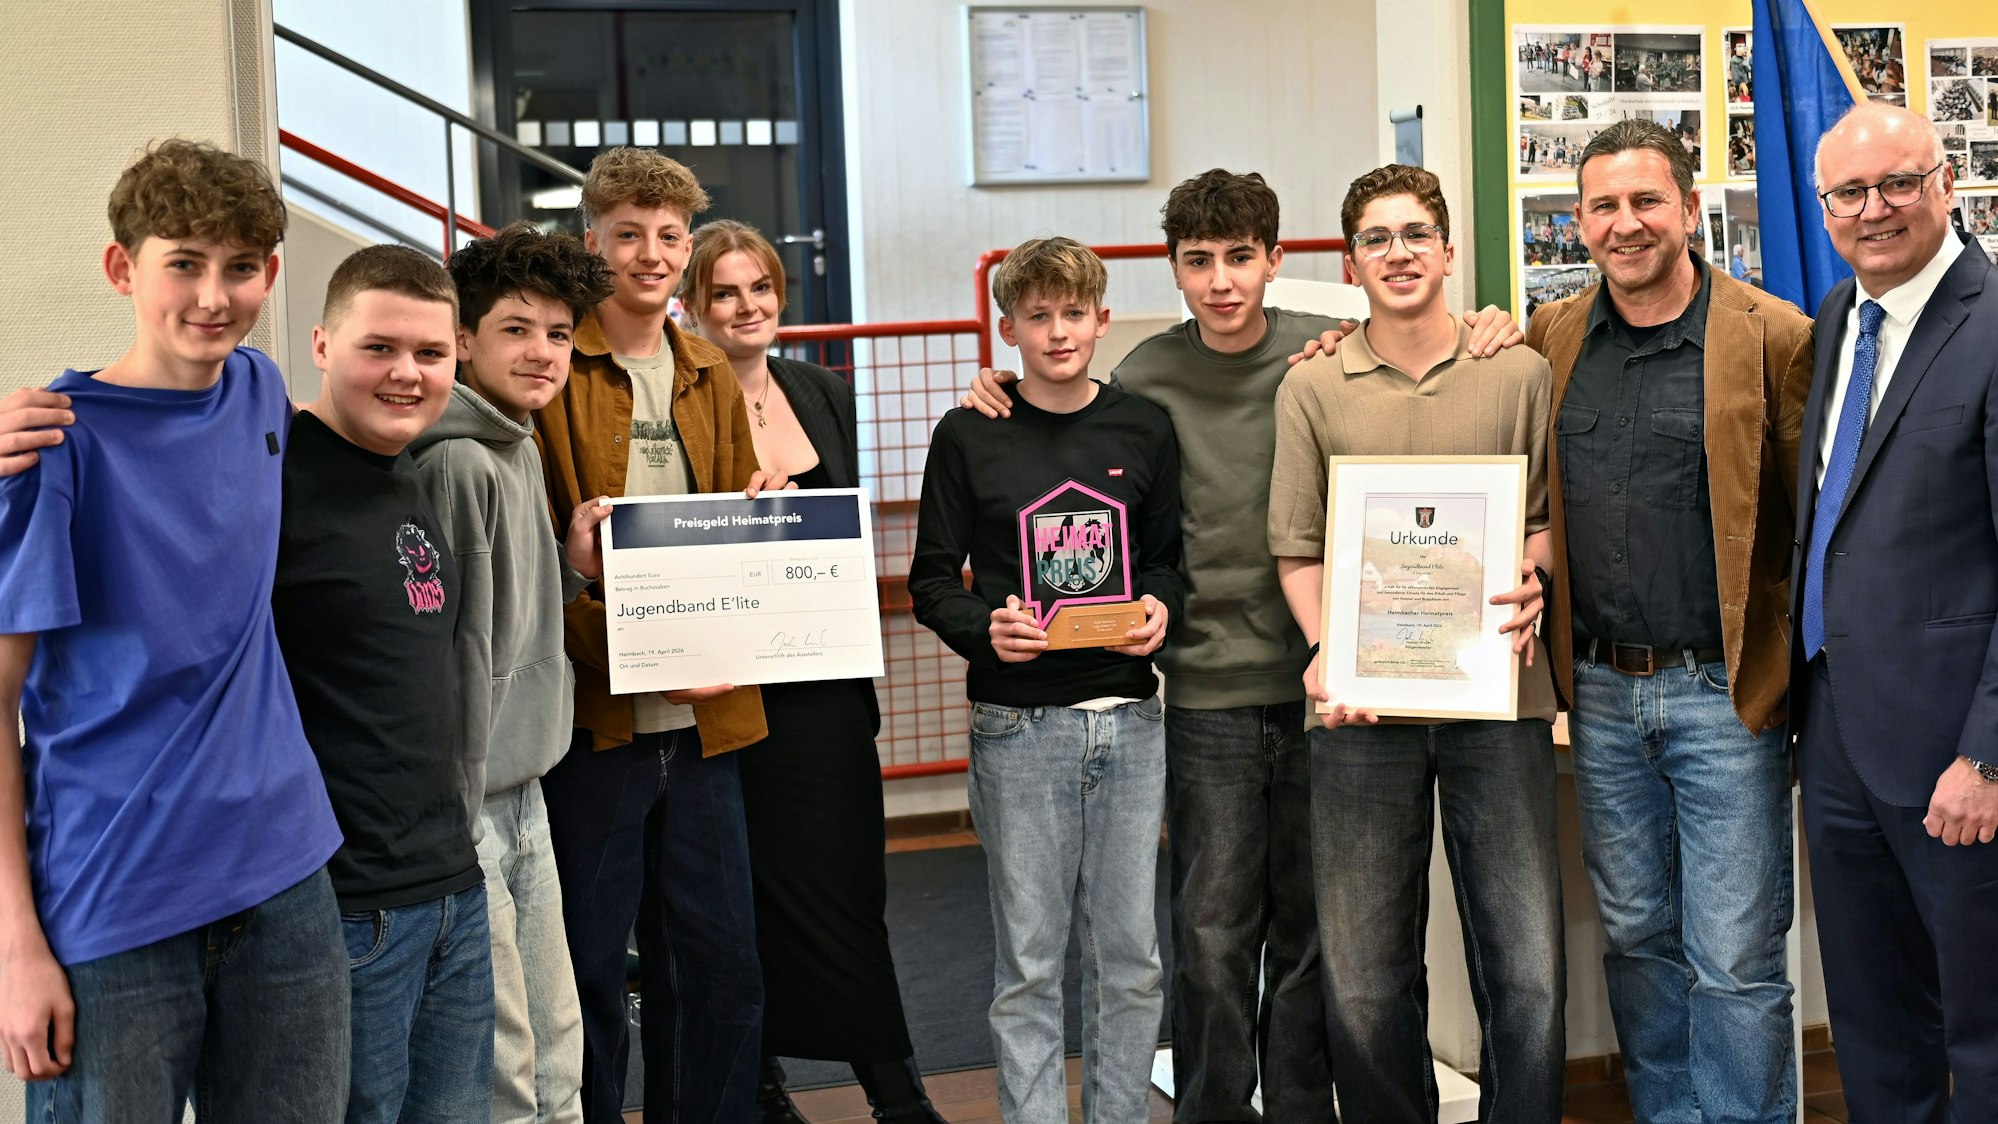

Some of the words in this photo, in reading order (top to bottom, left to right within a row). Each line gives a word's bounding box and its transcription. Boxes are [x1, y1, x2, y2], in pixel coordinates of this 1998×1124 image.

[674, 516, 728, 530] Preisgeld
[732, 512, 802, 527] Heimatpreis
[1035, 522, 1113, 553] HEIMAT
[1390, 530, 1458, 546] Urkunde
[830, 564, 839, 578] €
[1037, 556, 1096, 585] PREIS
[617, 597, 716, 620] Jugendband
